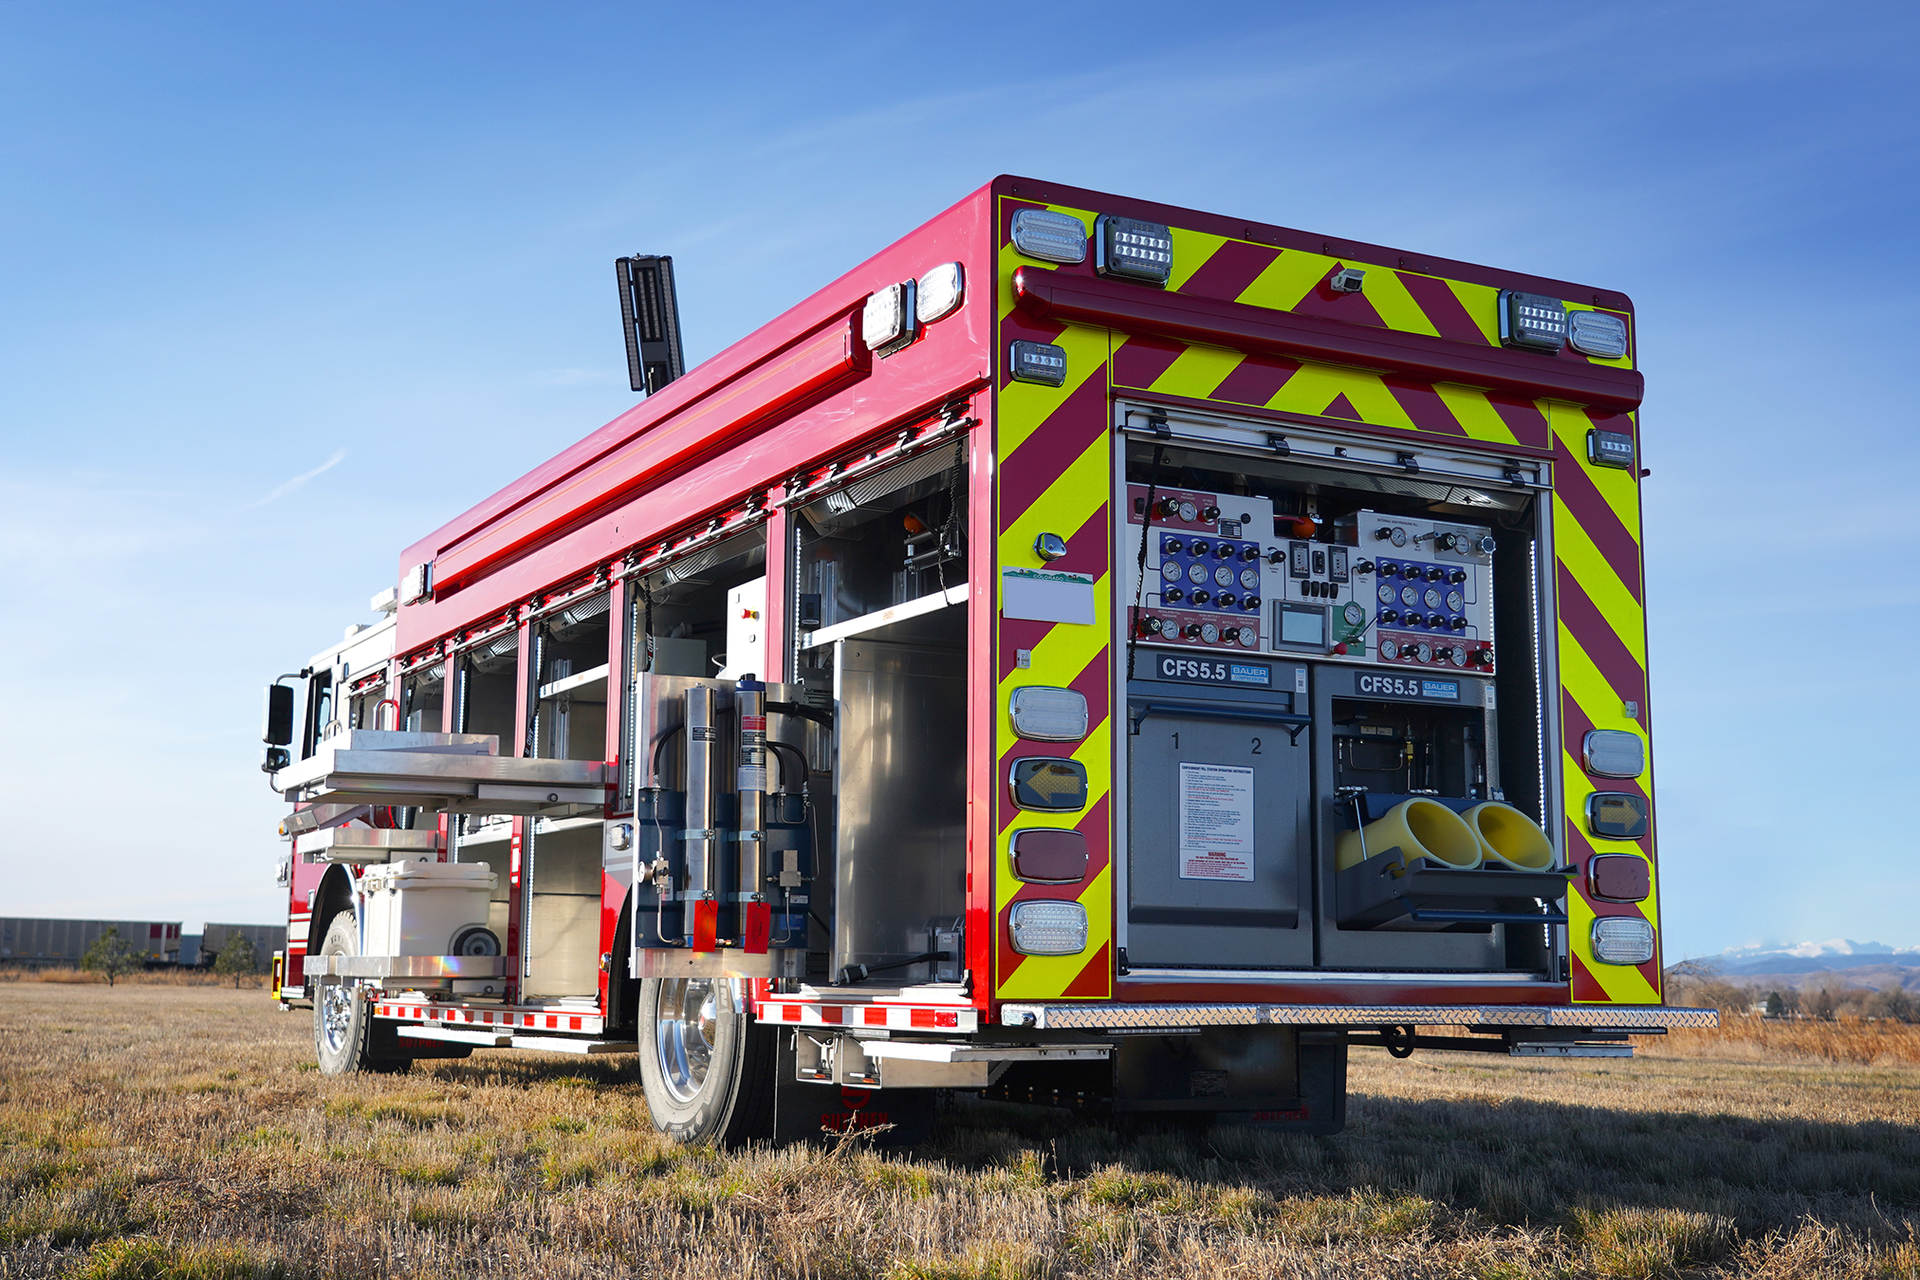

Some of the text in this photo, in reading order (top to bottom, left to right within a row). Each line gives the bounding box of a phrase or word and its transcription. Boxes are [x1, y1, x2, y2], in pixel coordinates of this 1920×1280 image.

[1033, 573, 1064, 582] COLORADO
[1162, 658, 1267, 681] CFS5.5 BAUER
[1234, 674, 1265, 682] COMPRESSORS
[1359, 675, 1455, 696] CFS5.5 BAUER
[1425, 690, 1454, 698] COMPRESSORS
[1171, 732, 1262, 755] 1 2
